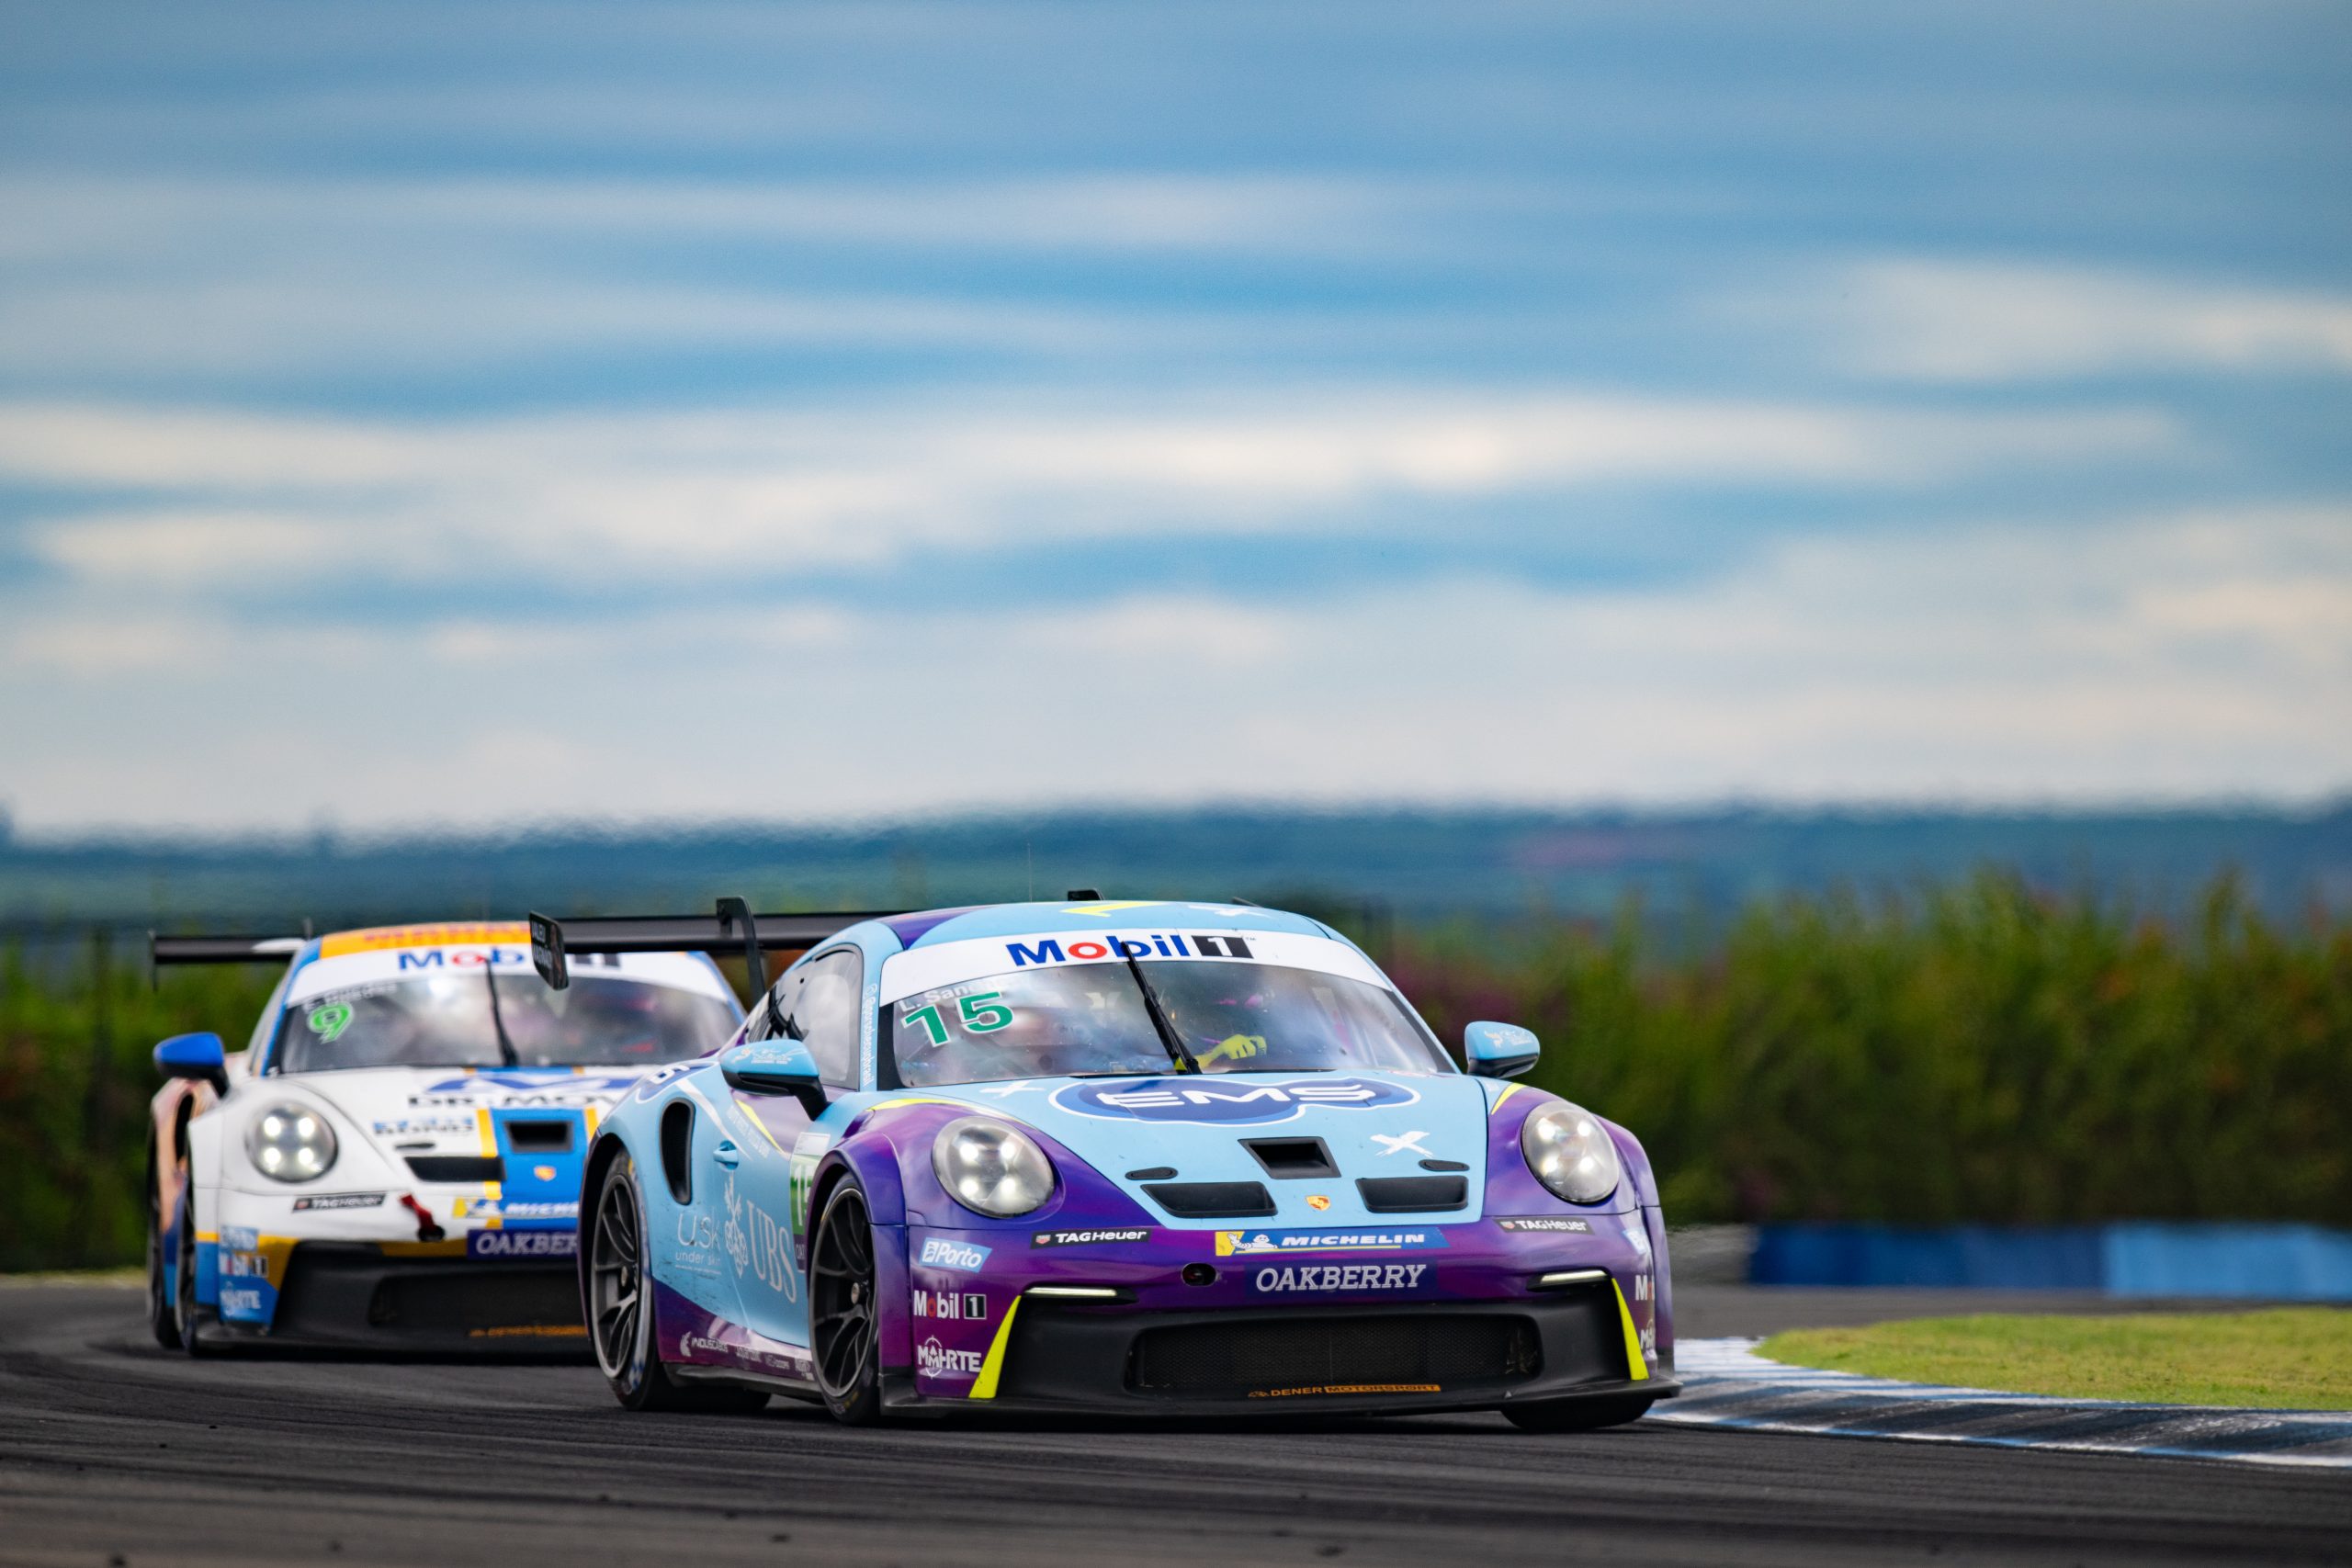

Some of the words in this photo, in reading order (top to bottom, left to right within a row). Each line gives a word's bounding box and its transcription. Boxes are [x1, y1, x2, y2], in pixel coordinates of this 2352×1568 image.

[398, 947, 526, 970] Mob
[1006, 935, 1191, 966] Mobil
[308, 1001, 354, 1045] 9
[901, 991, 1016, 1048] 15
[1097, 1084, 1376, 1108] EMS
[476, 1232, 579, 1255] OAKBE
[747, 1200, 797, 1304] UBS
[1281, 1234, 1426, 1247] MICHELIN
[935, 1241, 983, 1268] Porto
[1255, 1265, 1427, 1292] OAKBERRY
[913, 1290, 959, 1320] Mobil
[1271, 1387, 1323, 1396] DENER
